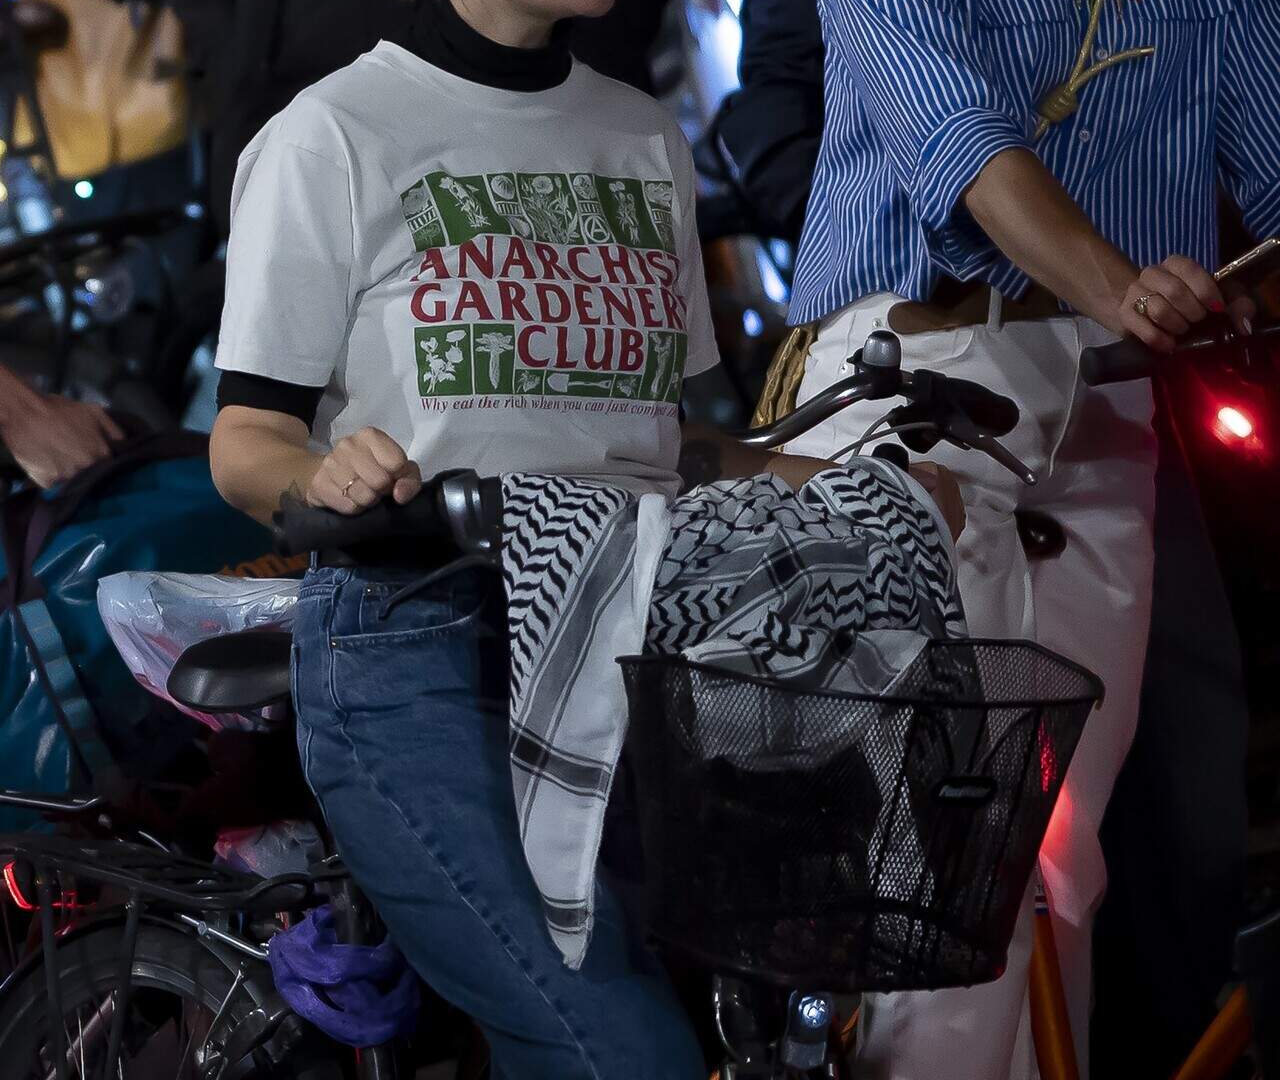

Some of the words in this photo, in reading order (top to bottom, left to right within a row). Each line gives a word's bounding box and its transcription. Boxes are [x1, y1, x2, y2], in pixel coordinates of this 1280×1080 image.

[409, 235, 681, 287] ANARCHIST
[517, 323, 646, 372] CLUB
[421, 396, 449, 414] Why
[452, 398, 474, 410] eat
[477, 395, 500, 410] the
[504, 395, 528, 410] rich
[530, 395, 560, 410] when
[560, 399, 581, 414] you
[584, 399, 605, 412] can
[604, 399, 630, 415] just
